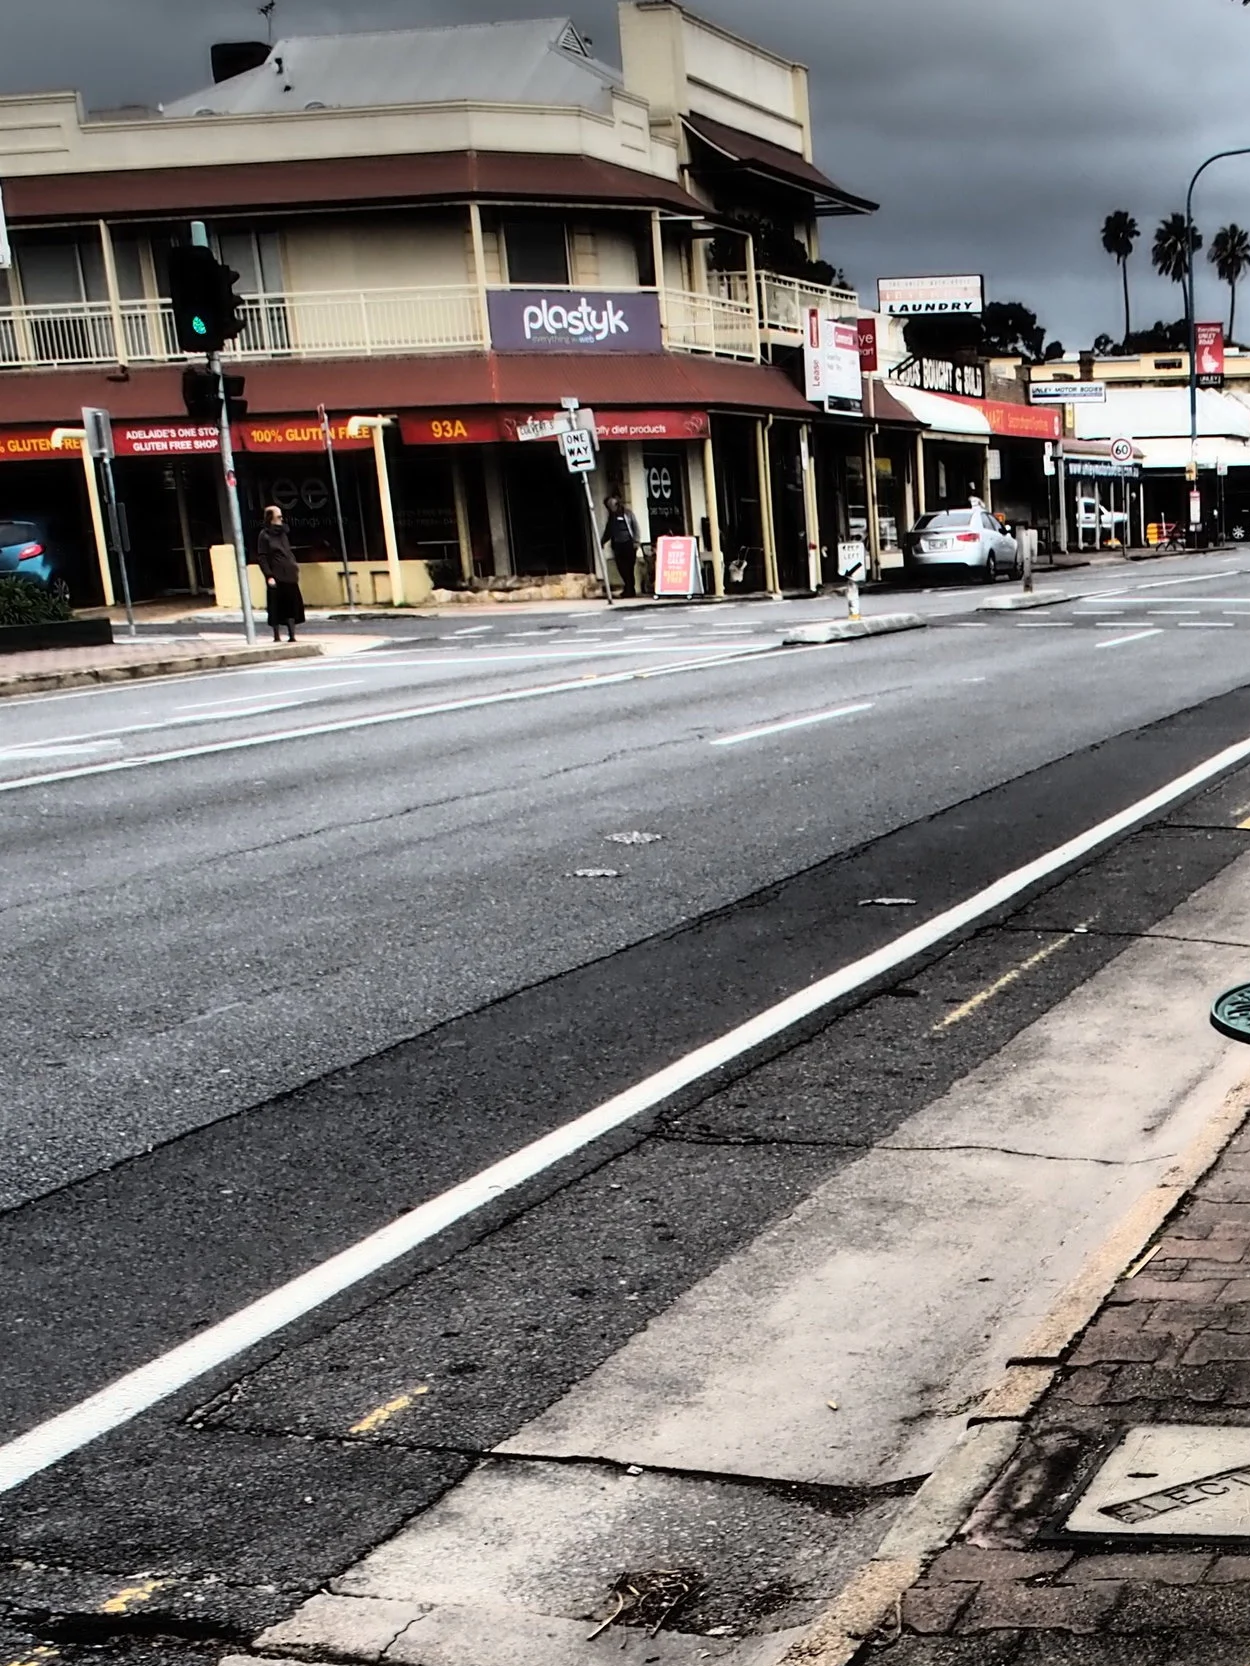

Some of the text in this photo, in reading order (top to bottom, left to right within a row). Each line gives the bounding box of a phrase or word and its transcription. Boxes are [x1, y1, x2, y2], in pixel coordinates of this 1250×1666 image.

[888, 301, 973, 313] LAUNDRY
[523, 297, 629, 341] plastyk
[578, 334, 595, 344] web
[859, 334, 874, 345] ye
[126, 428, 177, 440] ADELAIDE'S
[179, 427, 197, 438] ONE
[431, 420, 468, 438] 93A
[611, 425, 628, 434] diet
[629, 424, 667, 436] products
[250, 429, 283, 443] 100%
[566, 433, 585, 444] ONE
[133, 440, 218, 452] GLUTEN FREE SHOP
[567, 446, 588, 457] WAY
[1114, 445, 1128, 455] 60
